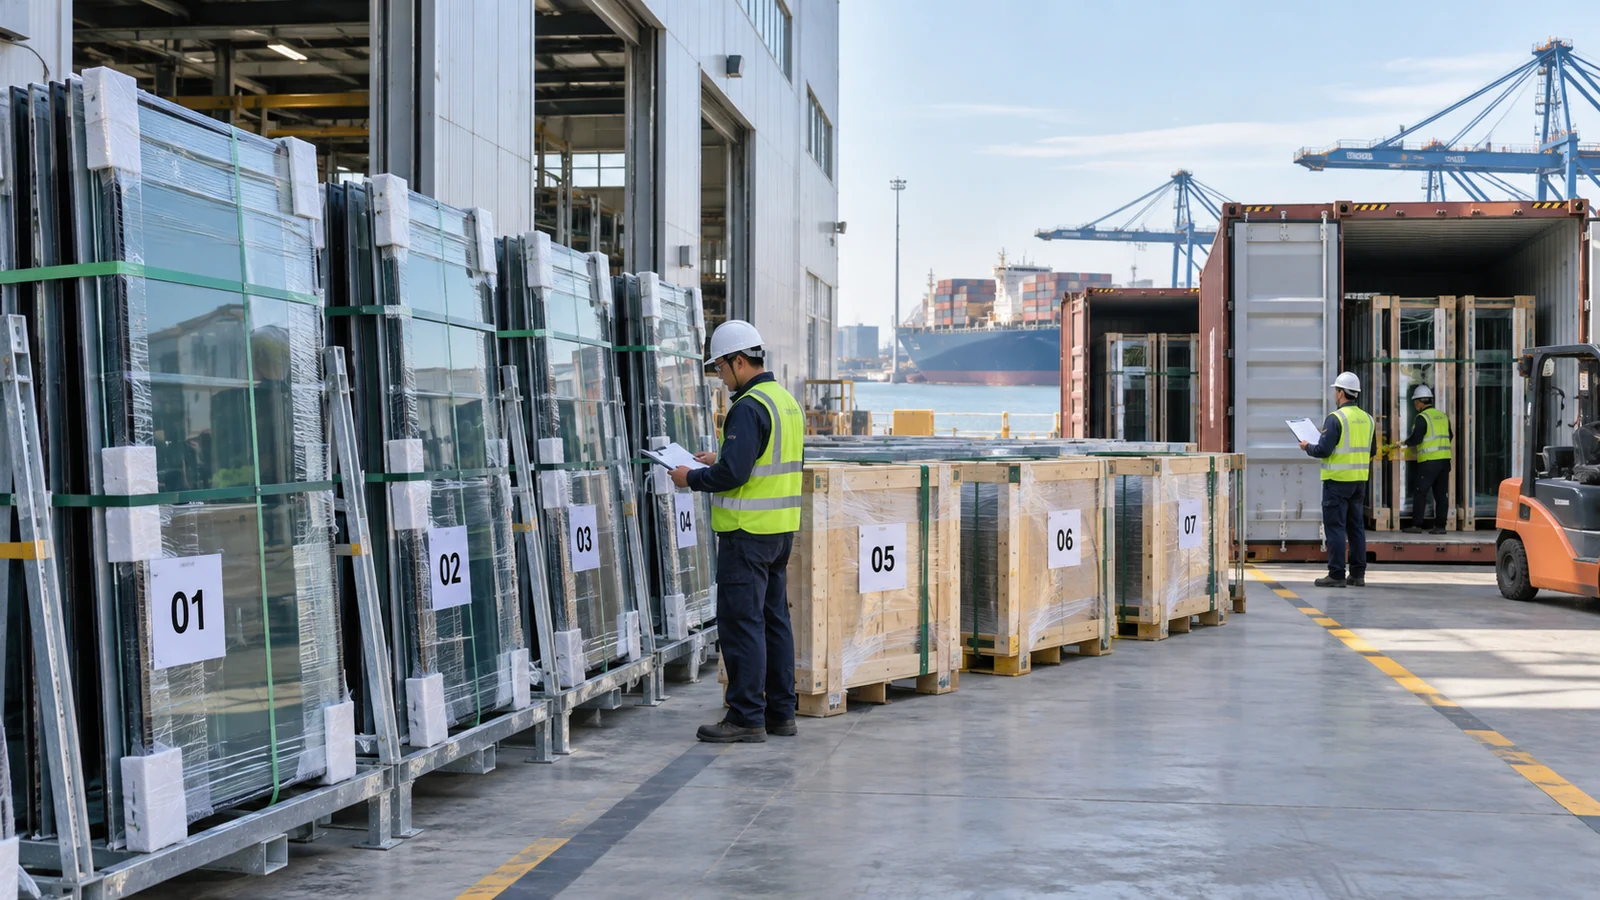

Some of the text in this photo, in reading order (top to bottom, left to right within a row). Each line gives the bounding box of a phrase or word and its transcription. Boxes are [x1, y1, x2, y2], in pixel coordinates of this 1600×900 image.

[679, 510, 692, 533] 04
[1184, 514, 1197, 535] 07
[576, 526, 592, 553] 03
[1056, 528, 1073, 552] 06
[439, 552, 462, 586] 02
[871, 545, 895, 573] 05
[171, 589, 205, 634] 01
